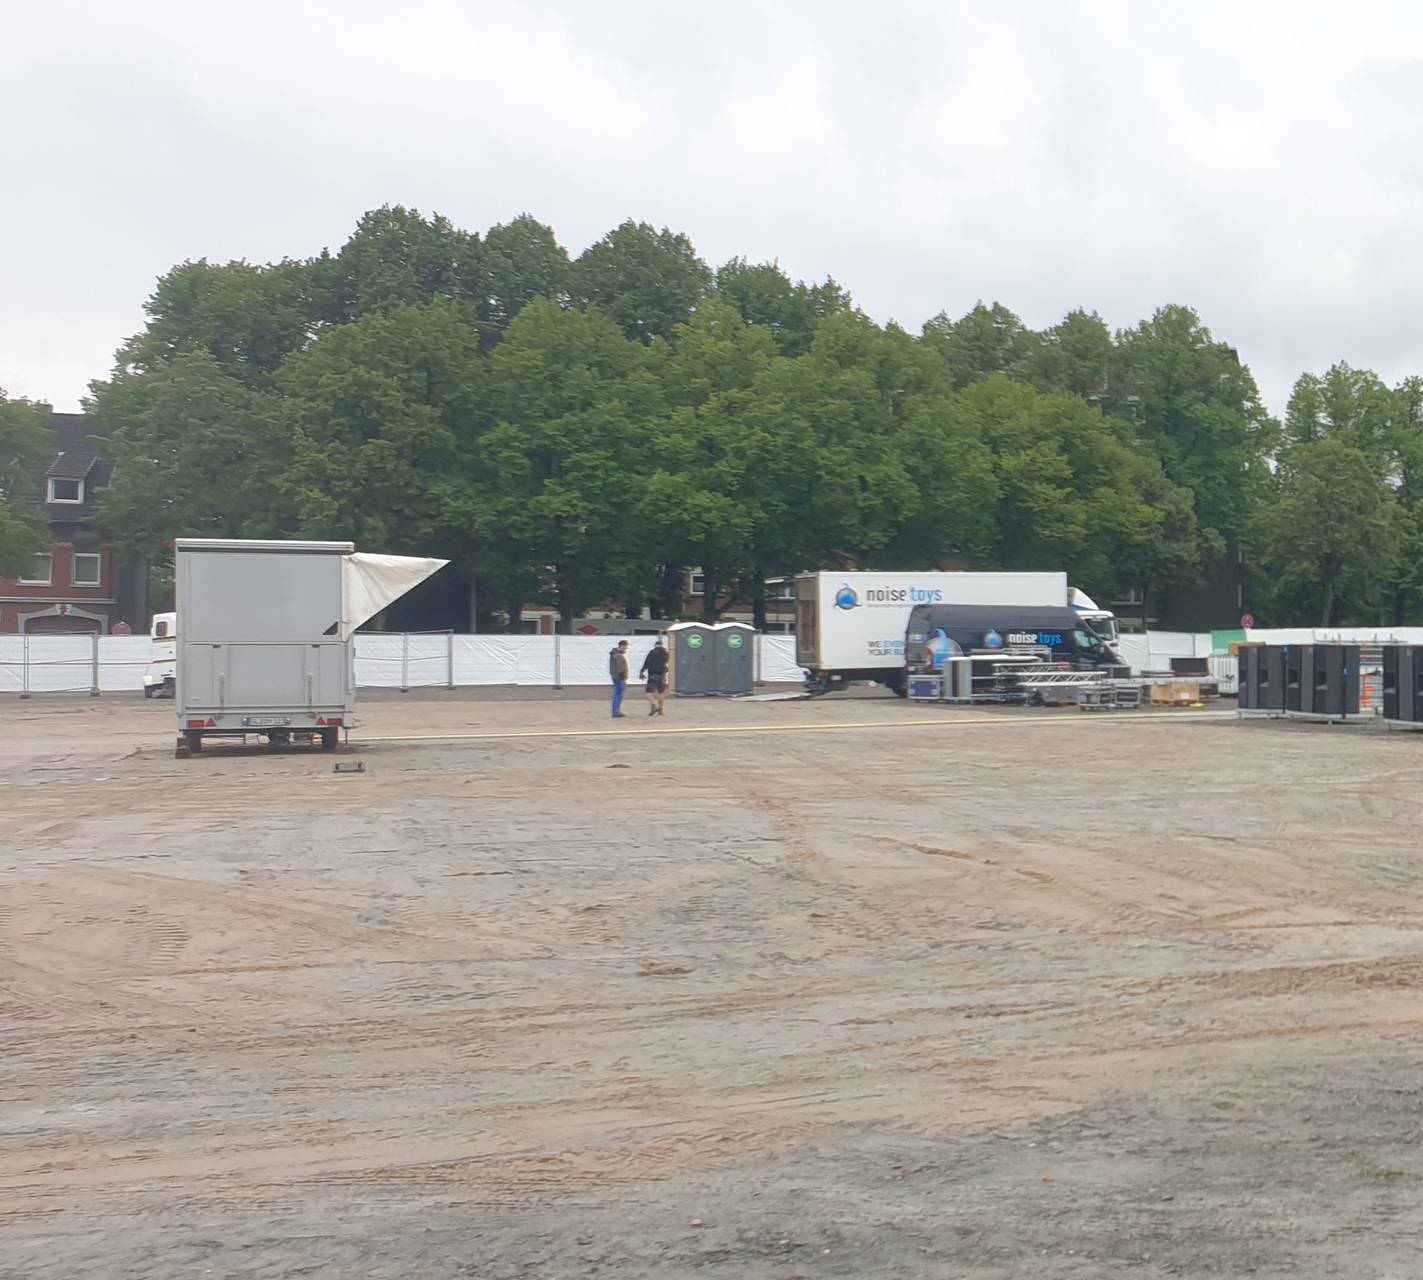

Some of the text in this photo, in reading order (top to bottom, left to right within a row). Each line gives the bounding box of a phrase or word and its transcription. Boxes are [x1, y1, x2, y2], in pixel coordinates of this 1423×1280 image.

[866, 586, 943, 605] noise toys
[867, 640, 882, 648] WE
[1008, 631, 1062, 646] noise toys
